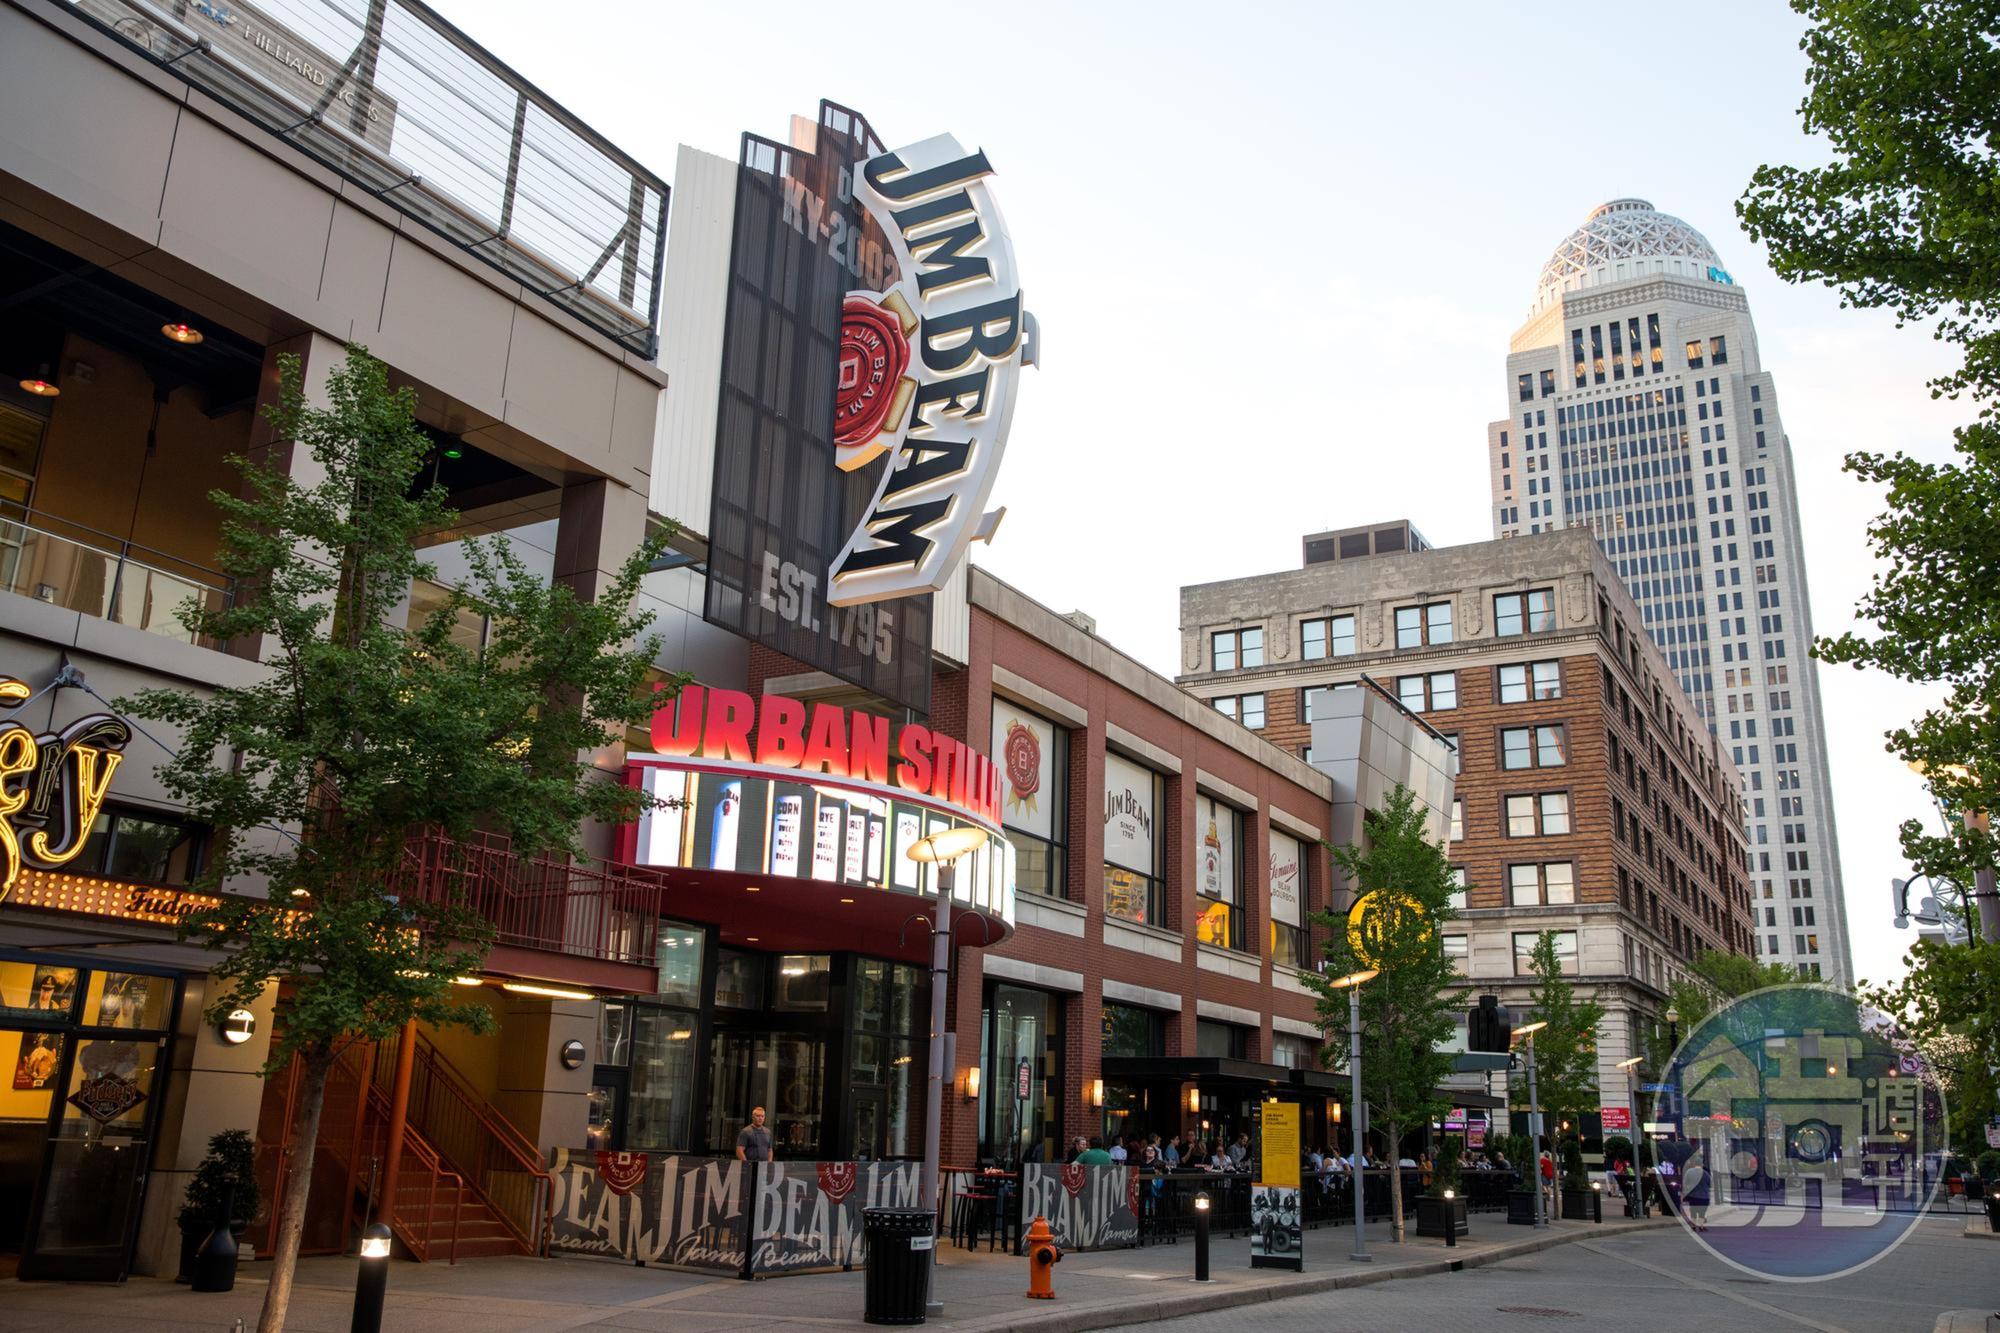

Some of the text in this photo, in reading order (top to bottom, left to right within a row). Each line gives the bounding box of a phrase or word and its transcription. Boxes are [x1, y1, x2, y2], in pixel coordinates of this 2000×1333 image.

[244, 25, 325, 87] HILLIARD
[832, 146, 1025, 583] JIM BEAM
[849, 328, 885, 415] JIM BEAM
[760, 550, 820, 633] EST.
[650, 681, 890, 786] URBAN
[819, 812, 834, 824] RYE
[1104, 788, 1150, 840] JIM BEAM
[1120, 821, 1135, 832] SINCE
[638, 1155, 743, 1261] JIM
